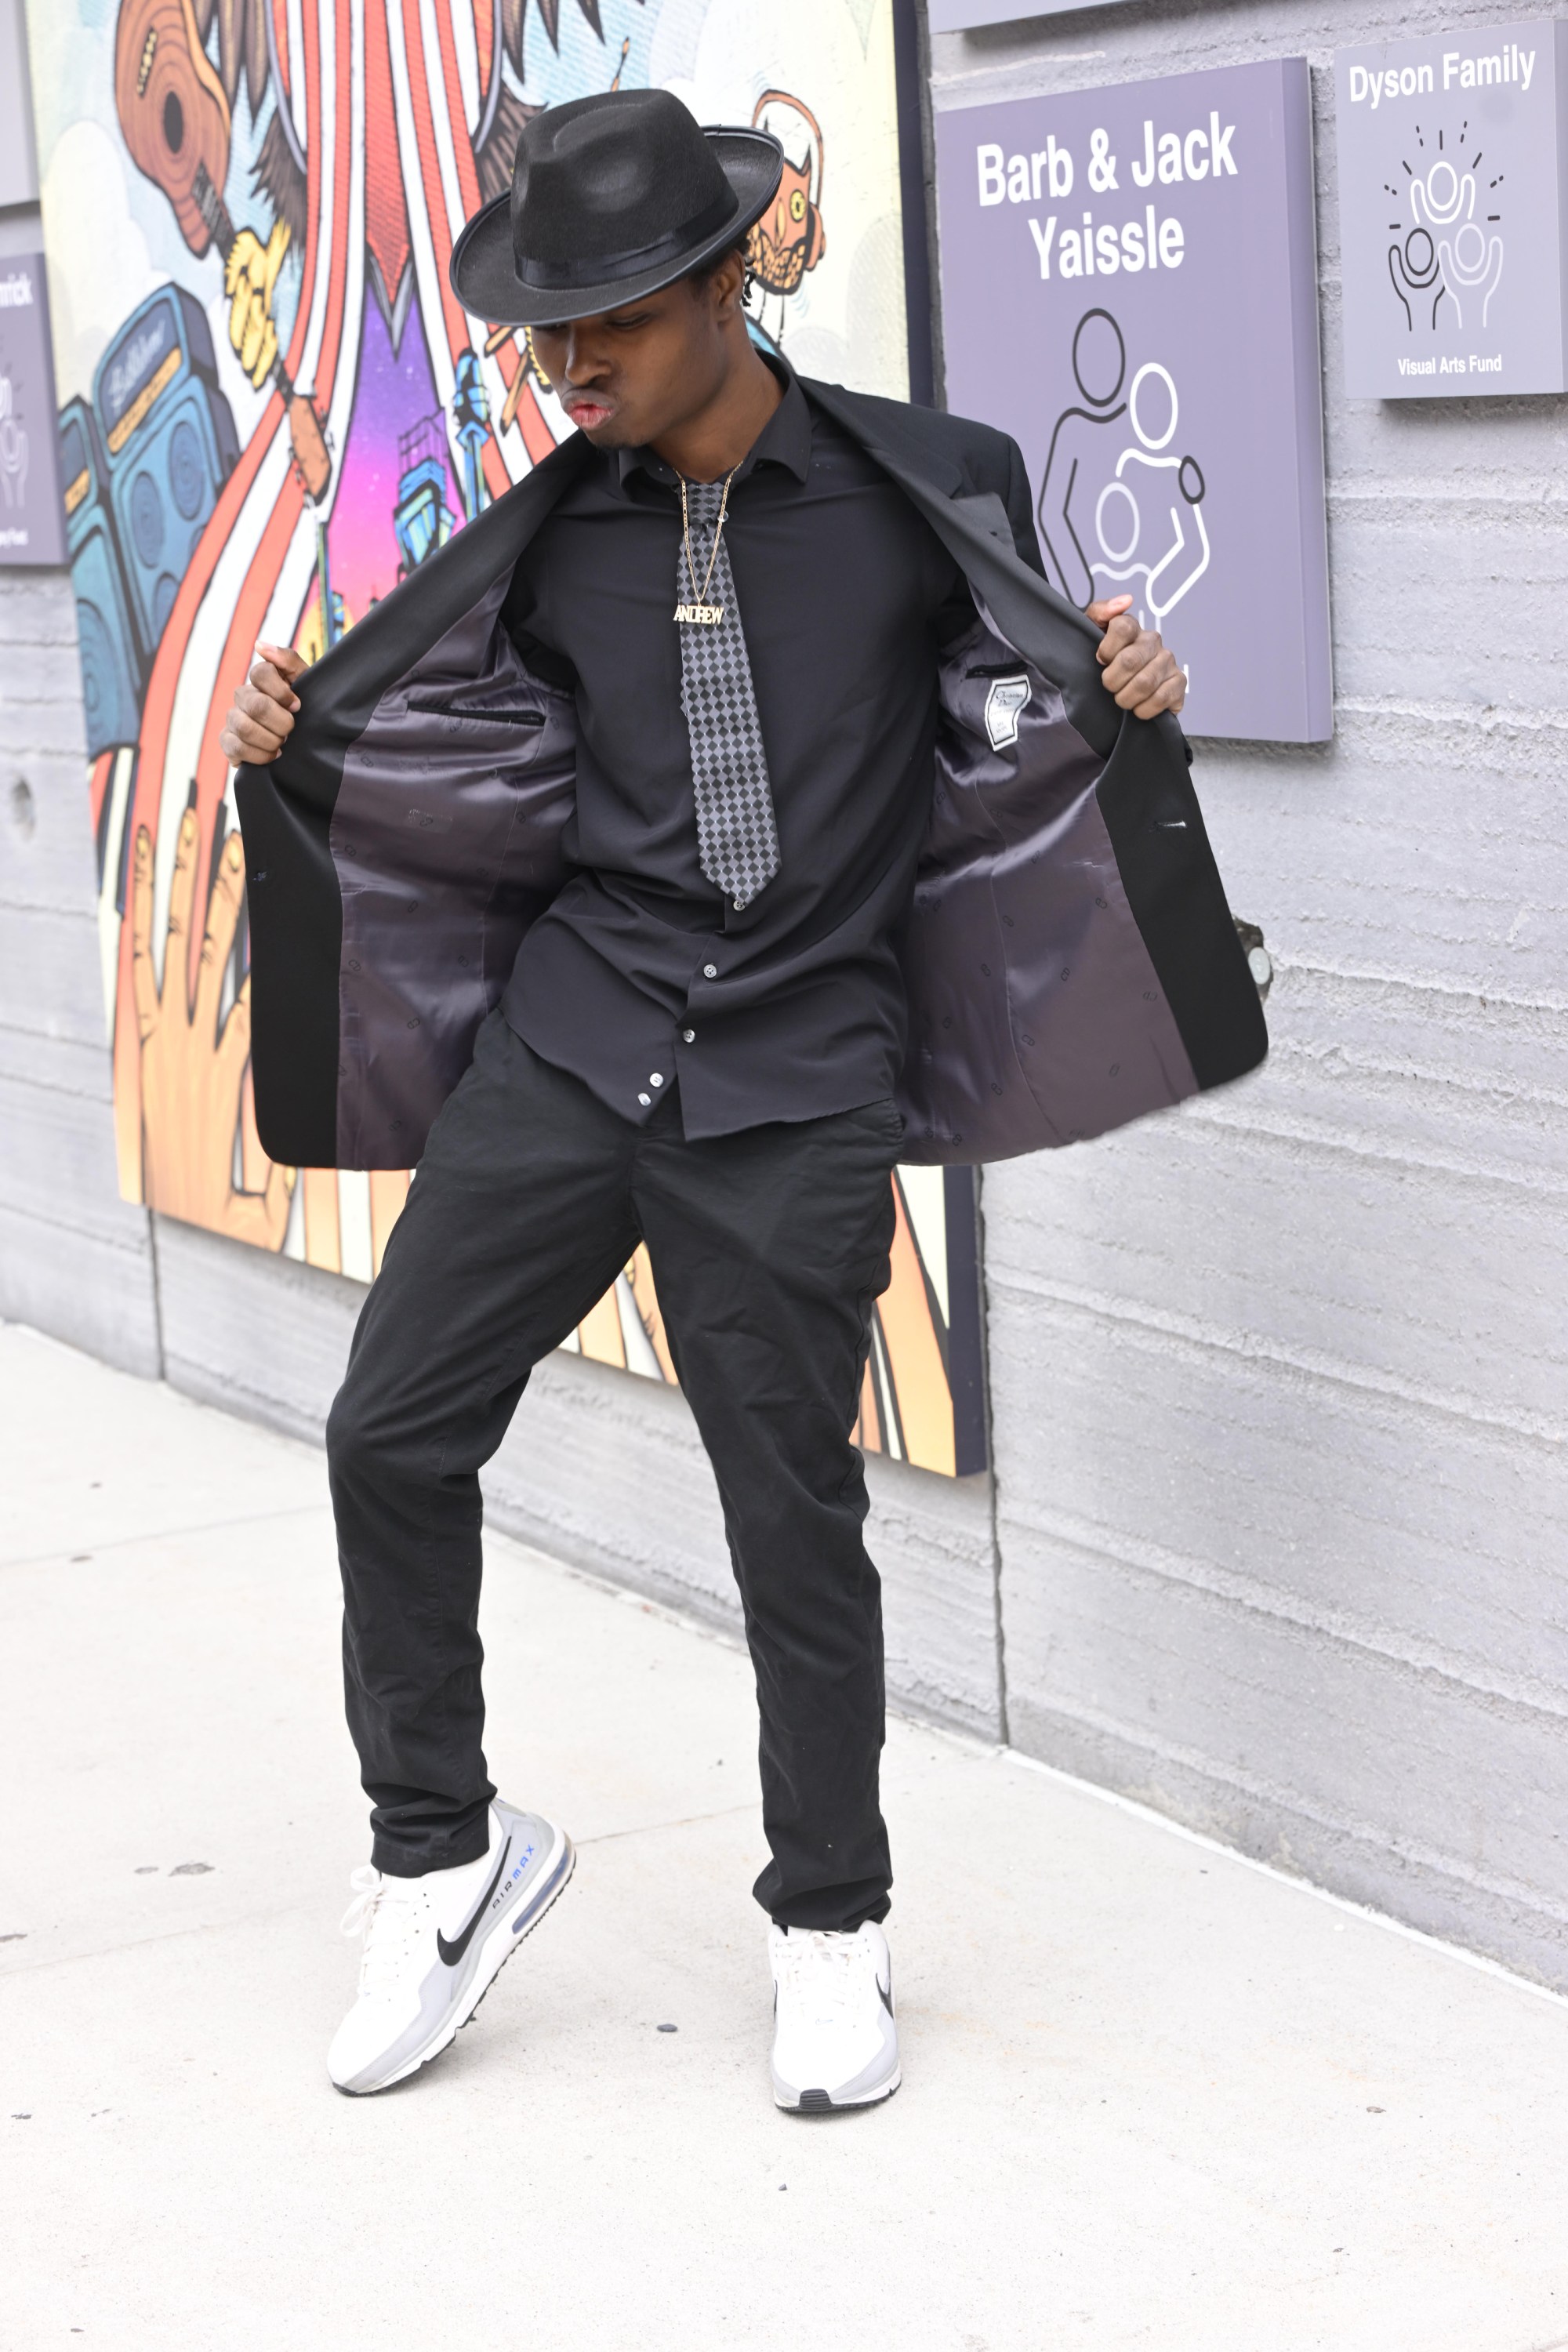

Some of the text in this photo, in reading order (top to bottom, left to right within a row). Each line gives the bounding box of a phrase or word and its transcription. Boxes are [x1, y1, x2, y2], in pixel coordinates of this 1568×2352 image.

[1349, 44, 1536, 110] Dyson Family
[977, 111, 1238, 207] Barb & Jack
[1029, 204, 1185, 280] Yaissle
[1397, 354, 1502, 376] Visual Arts Fund
[673, 604, 724, 625] ANDREW
